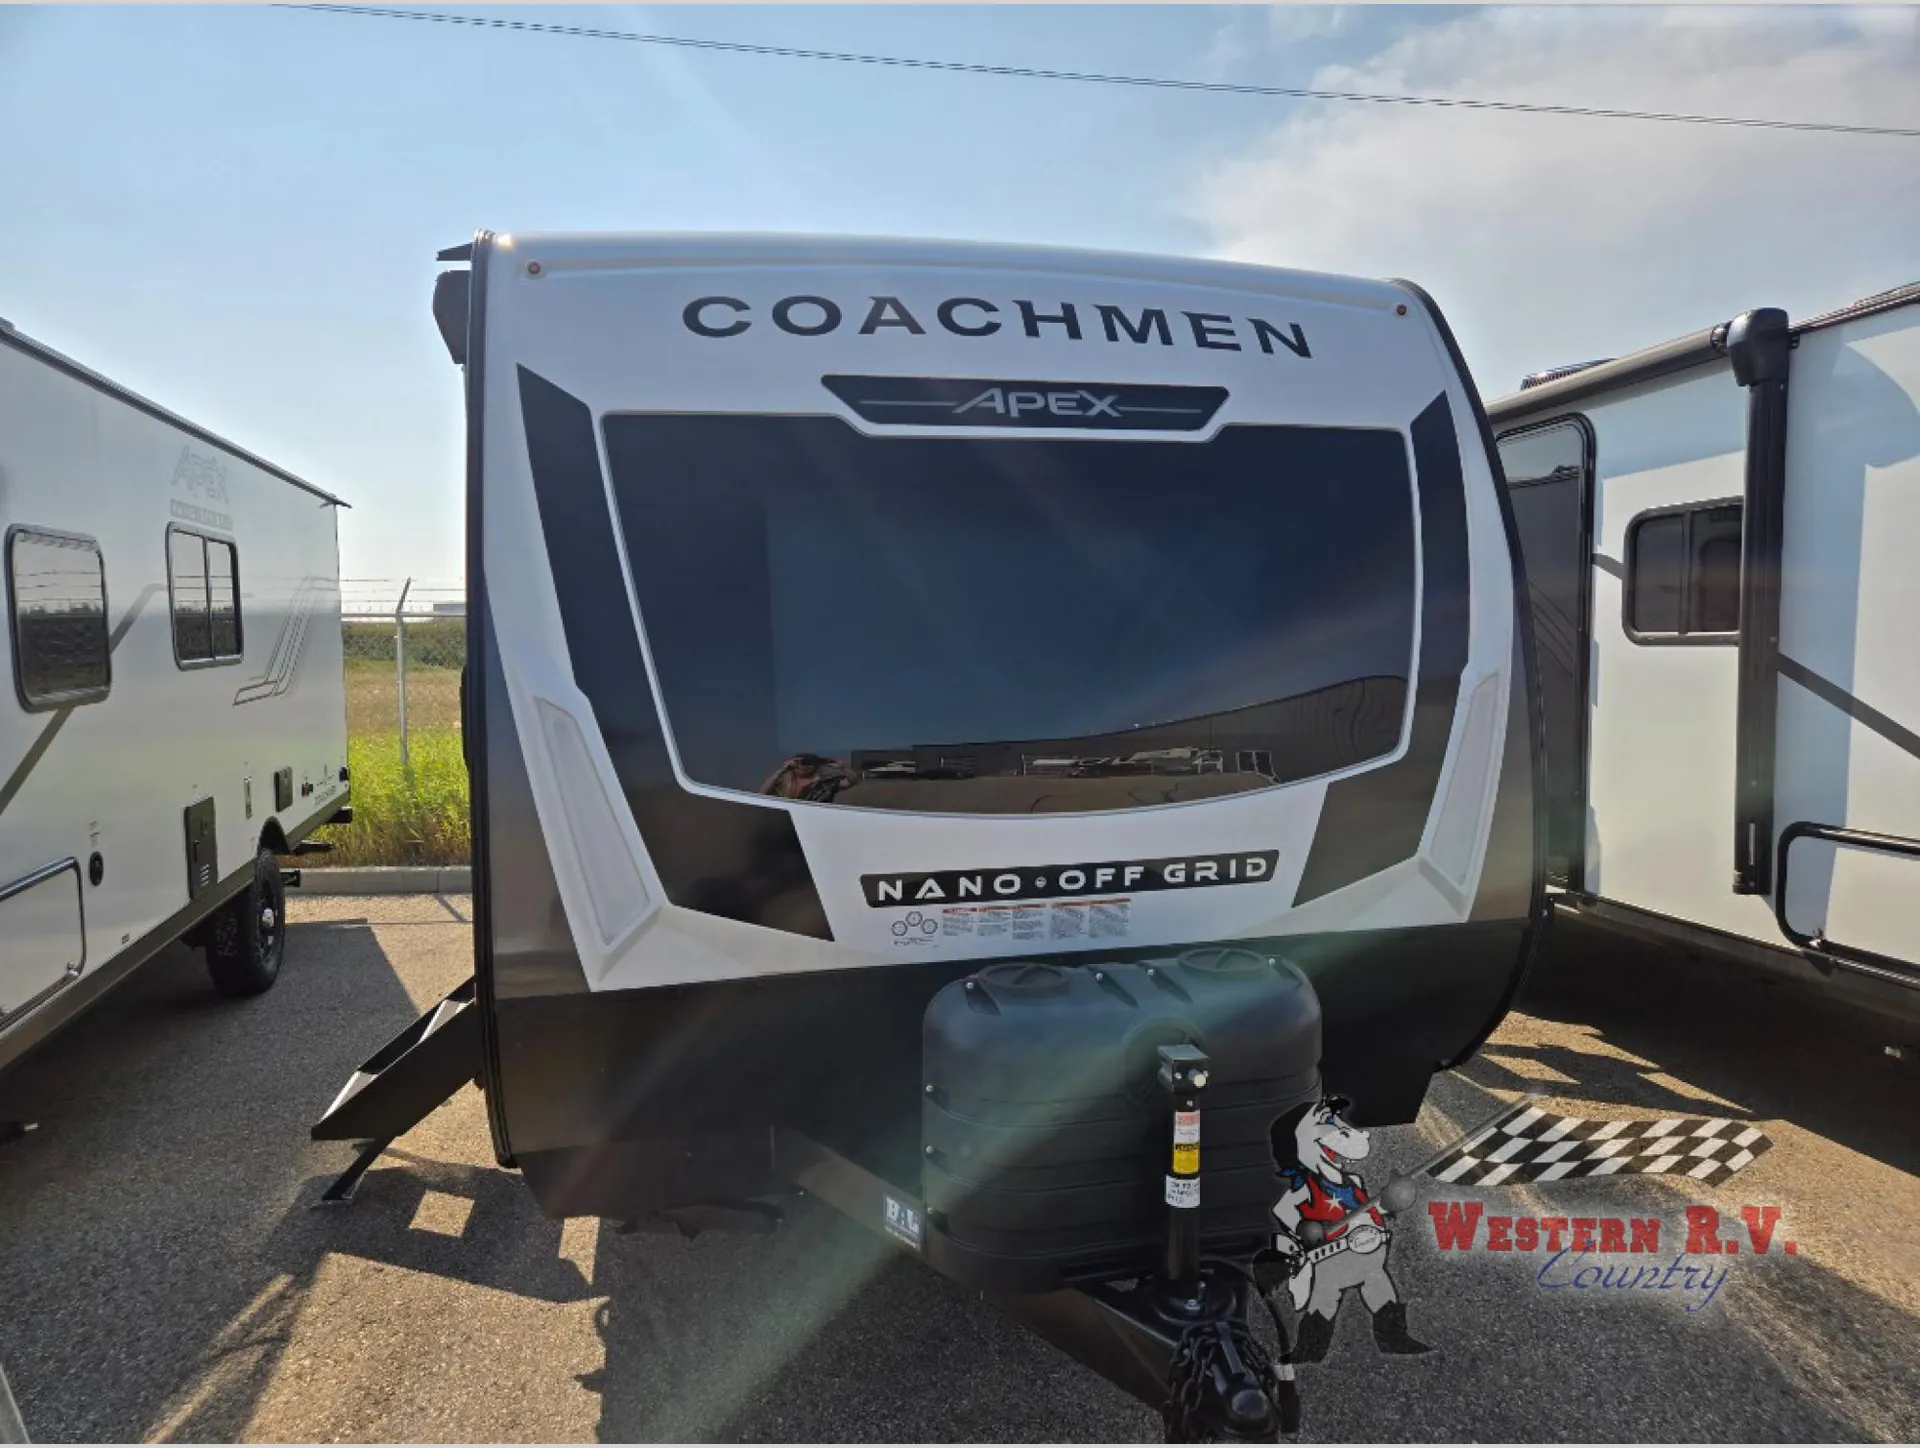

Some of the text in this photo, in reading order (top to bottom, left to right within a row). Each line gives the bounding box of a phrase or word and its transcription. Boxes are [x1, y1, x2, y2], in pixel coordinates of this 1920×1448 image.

[682, 296, 1312, 359] COACHMEN
[951, 387, 1125, 418] APEX
[878, 856, 1268, 901] NANO OFF GRID
